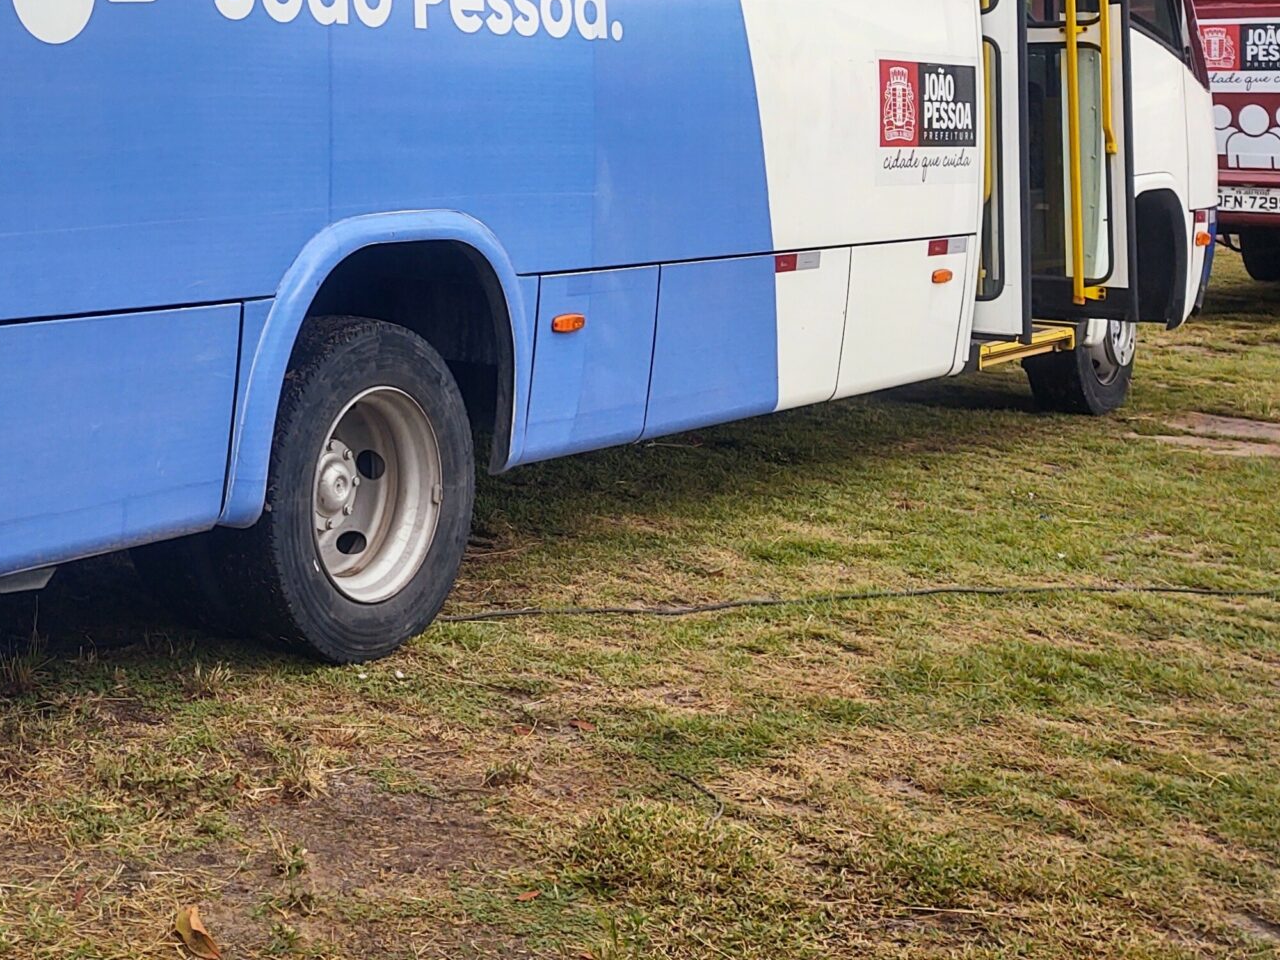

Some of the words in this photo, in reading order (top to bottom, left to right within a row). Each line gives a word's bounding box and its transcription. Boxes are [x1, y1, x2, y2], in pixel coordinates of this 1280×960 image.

[924, 67, 955, 101] JOÃO
[1244, 76, 1271, 91] que
[923, 102, 972, 129] PESSOA
[923, 131, 974, 140] PREFEITURA
[883, 149, 920, 170] cidade
[921, 156, 941, 182] que
[942, 148, 971, 167] cuida
